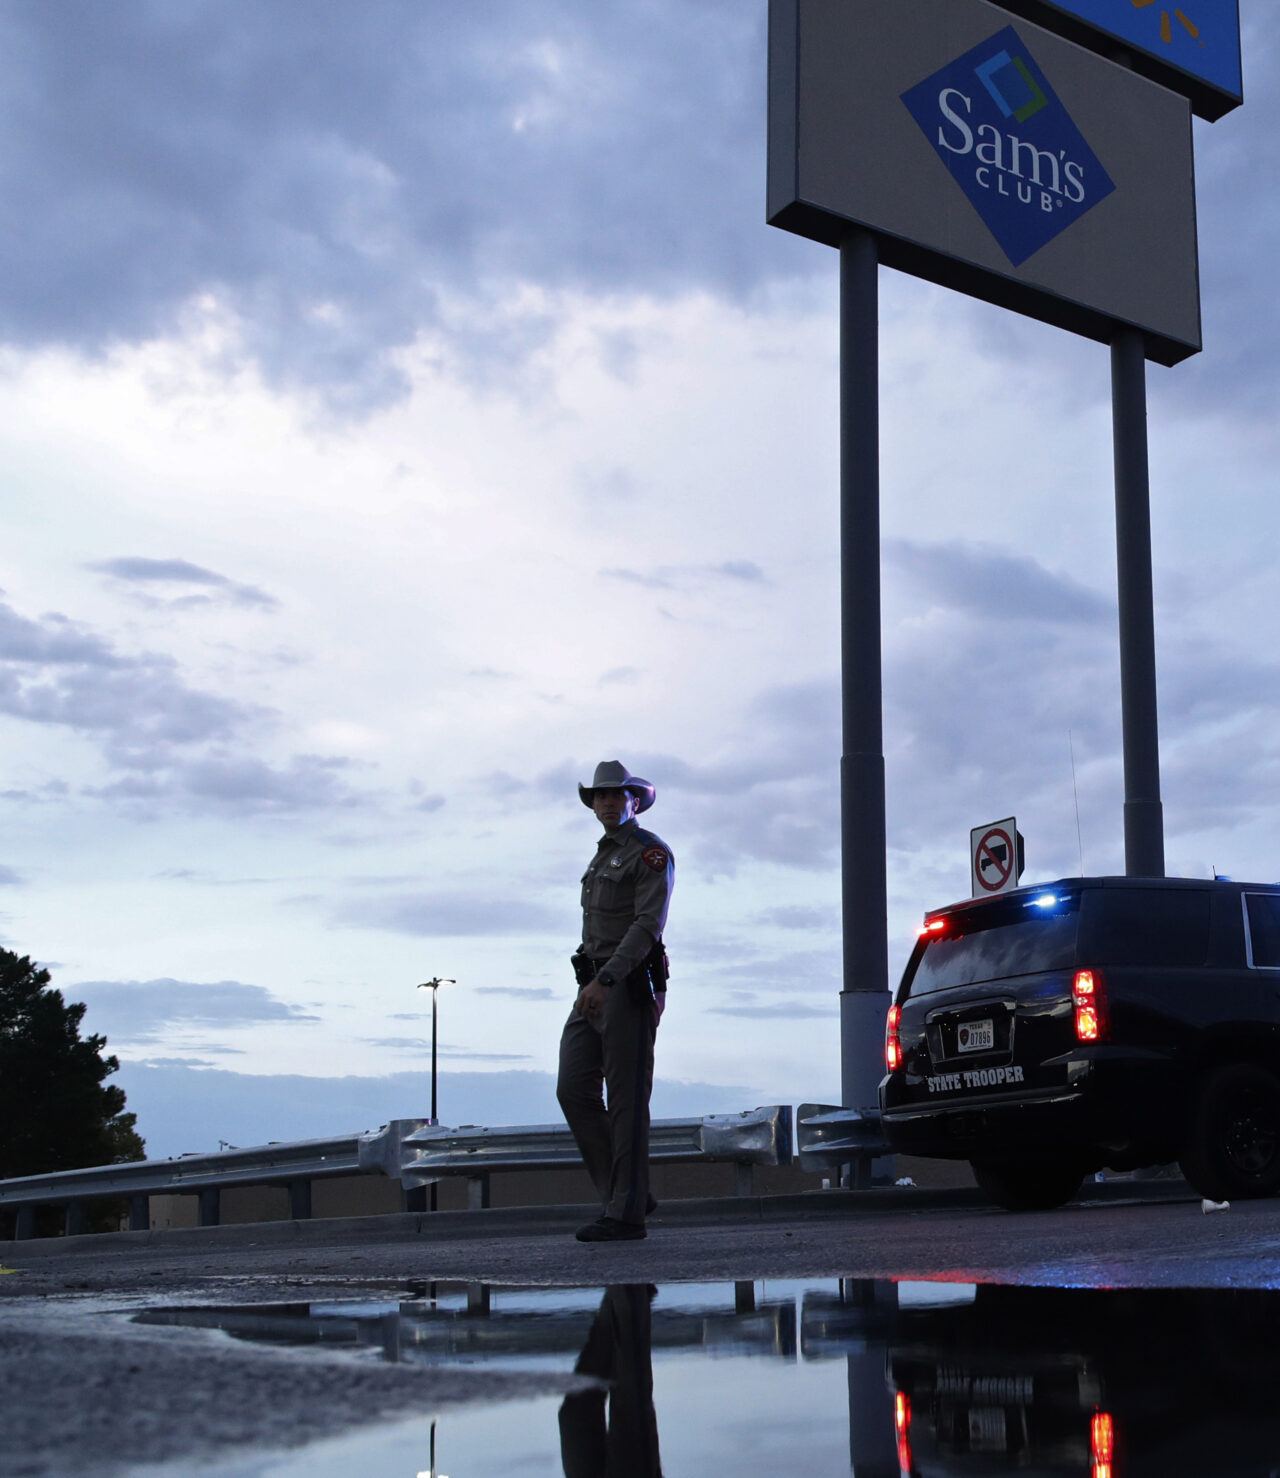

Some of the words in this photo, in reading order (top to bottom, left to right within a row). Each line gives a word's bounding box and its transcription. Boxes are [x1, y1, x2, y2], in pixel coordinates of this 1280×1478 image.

[938, 88, 1085, 203] Sam's
[970, 1030, 991, 1045] 07896
[928, 1073, 961, 1093] STATE
[963, 1065, 1025, 1088] TROOPER
